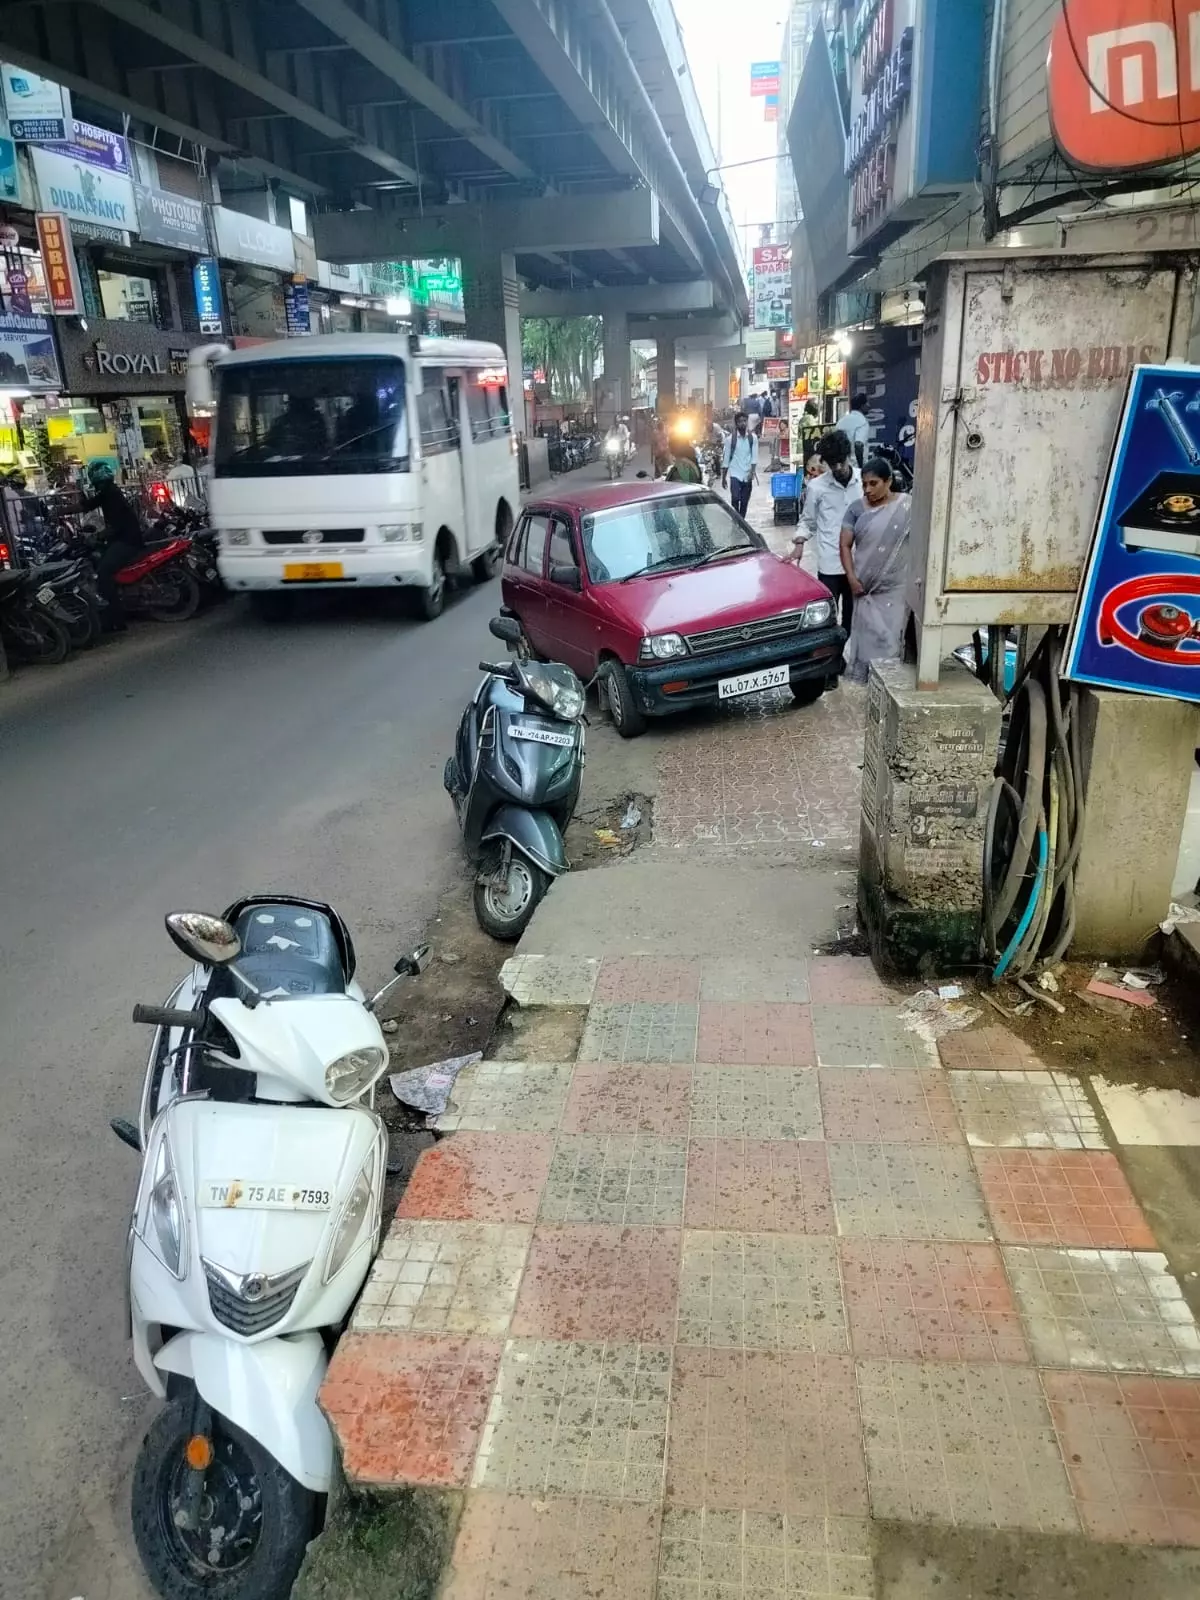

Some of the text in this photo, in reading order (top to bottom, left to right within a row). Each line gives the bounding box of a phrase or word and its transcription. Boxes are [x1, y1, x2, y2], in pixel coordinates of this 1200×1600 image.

[81, 125, 120, 147] HOSPITAL
[91, 200, 126, 223] FANCY
[43, 218, 66, 296] DUBAI
[202, 296, 213, 312] MAX
[98, 351, 167, 375] ROYAL
[976, 350, 1044, 385] STICK
[1052, 348, 1082, 379] NO
[722, 671, 785, 695] KL.07.X.5767
[513, 728, 523, 736] TN
[554, 736, 571, 745] 2203
[210, 1186, 329, 1205] TN 75 AE 7593
